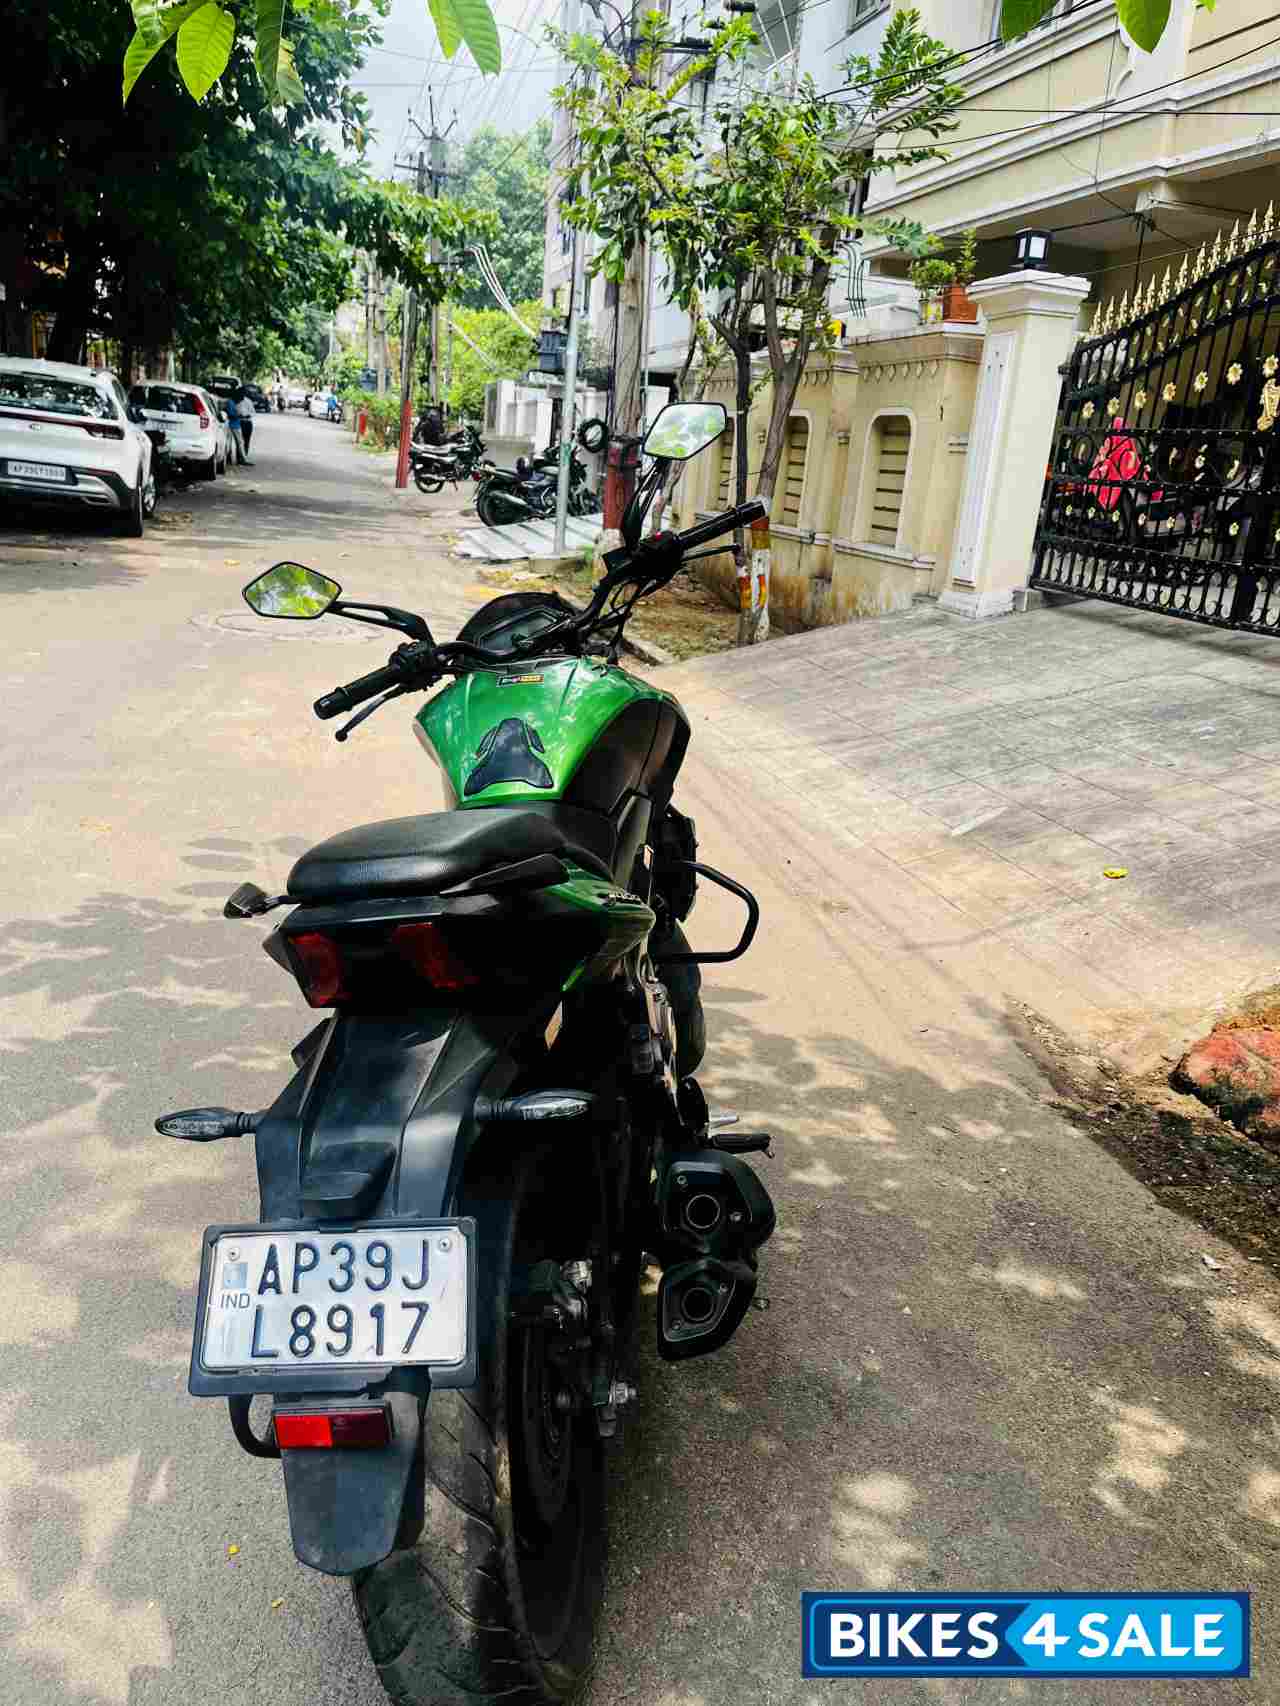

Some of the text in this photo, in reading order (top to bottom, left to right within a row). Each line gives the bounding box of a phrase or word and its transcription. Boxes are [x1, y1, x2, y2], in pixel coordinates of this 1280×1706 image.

[257, 1239, 429, 1295] AP39J
[220, 1293, 250, 1309] IND
[251, 1301, 430, 1358] L8917
